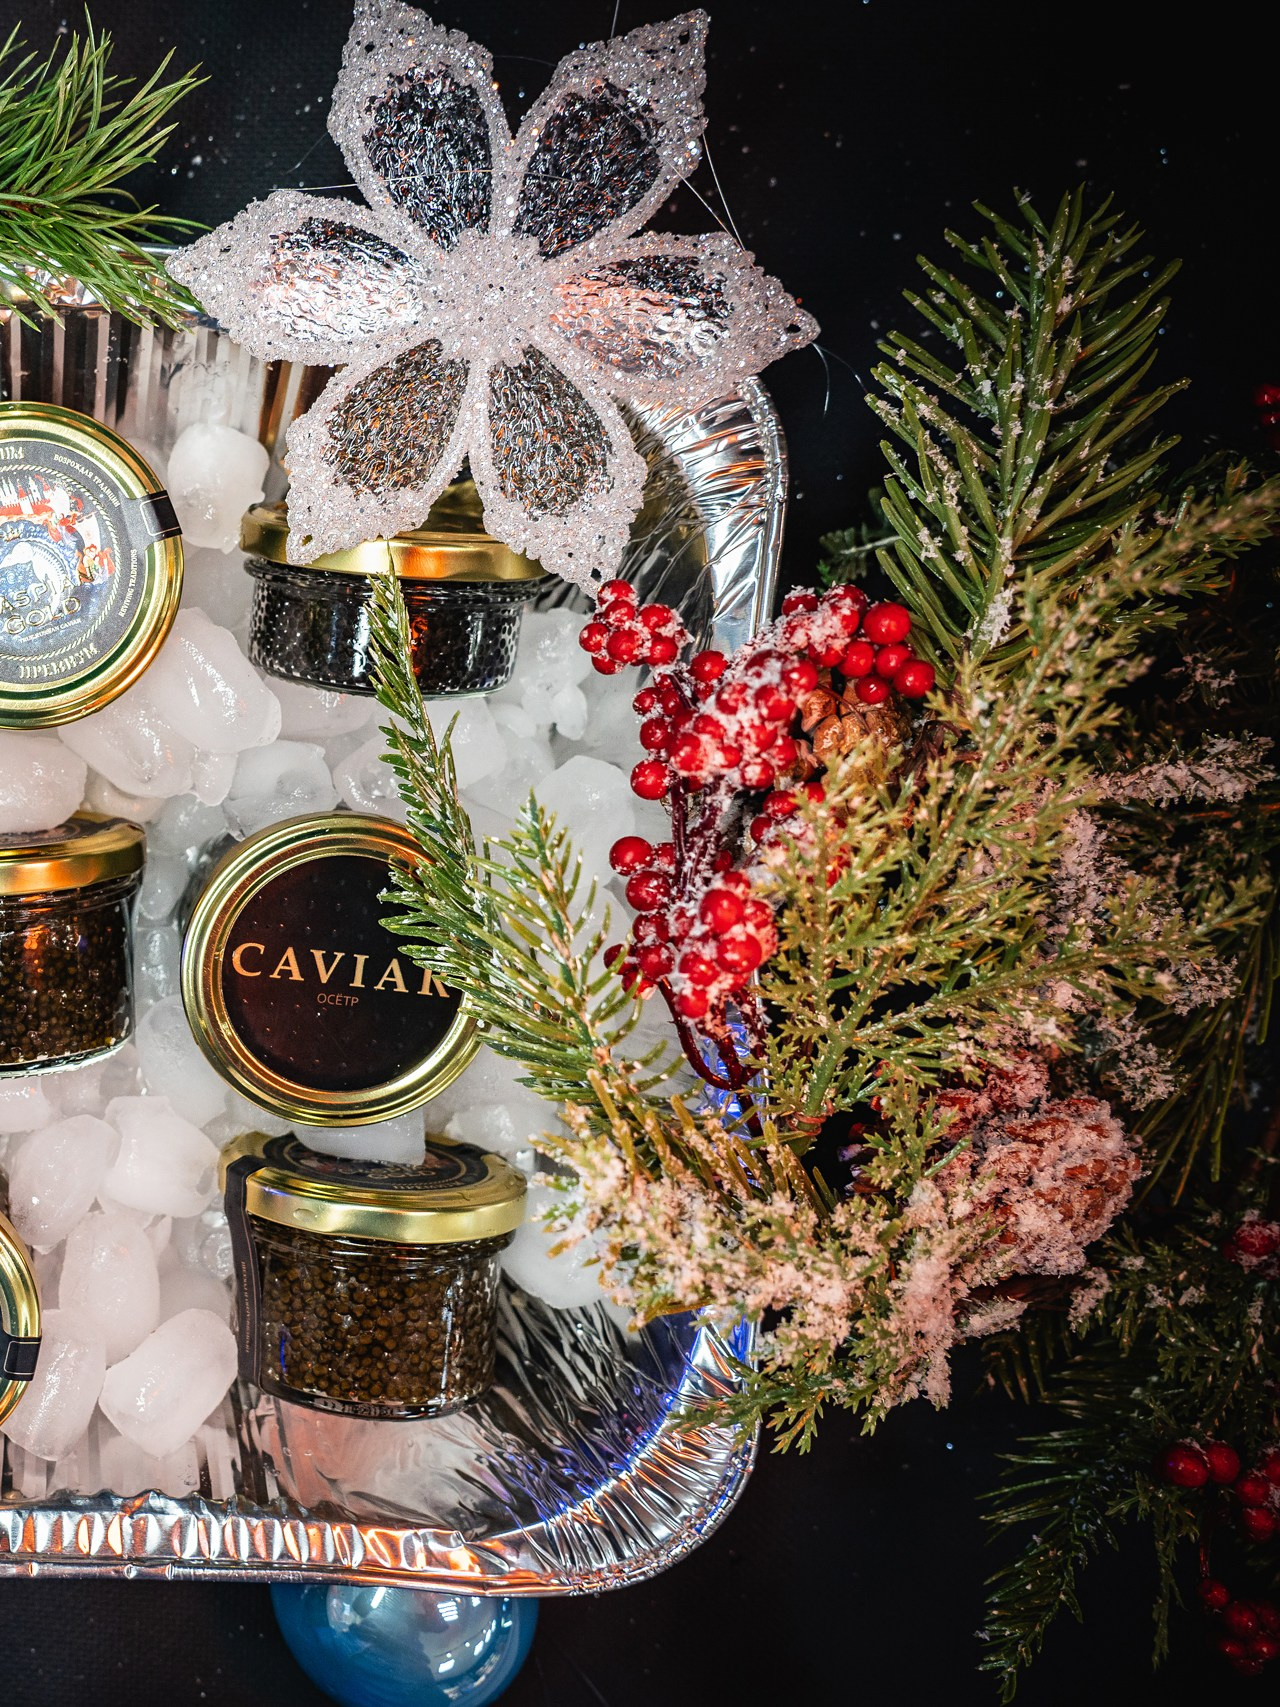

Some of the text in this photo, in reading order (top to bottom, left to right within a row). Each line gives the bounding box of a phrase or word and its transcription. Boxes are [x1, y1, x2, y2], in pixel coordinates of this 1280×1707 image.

[53, 454, 121, 508] ВОЗРОЖДАЯ ТРАДИЦИИ
[118, 548, 138, 617] REVIVING TRADITIONS
[5, 596, 81, 635] GOLD
[19, 642, 100, 679] ПРЕМИУМ
[232, 942, 450, 998] CAVIAR
[317, 993, 360, 1007] ОСЁТР
